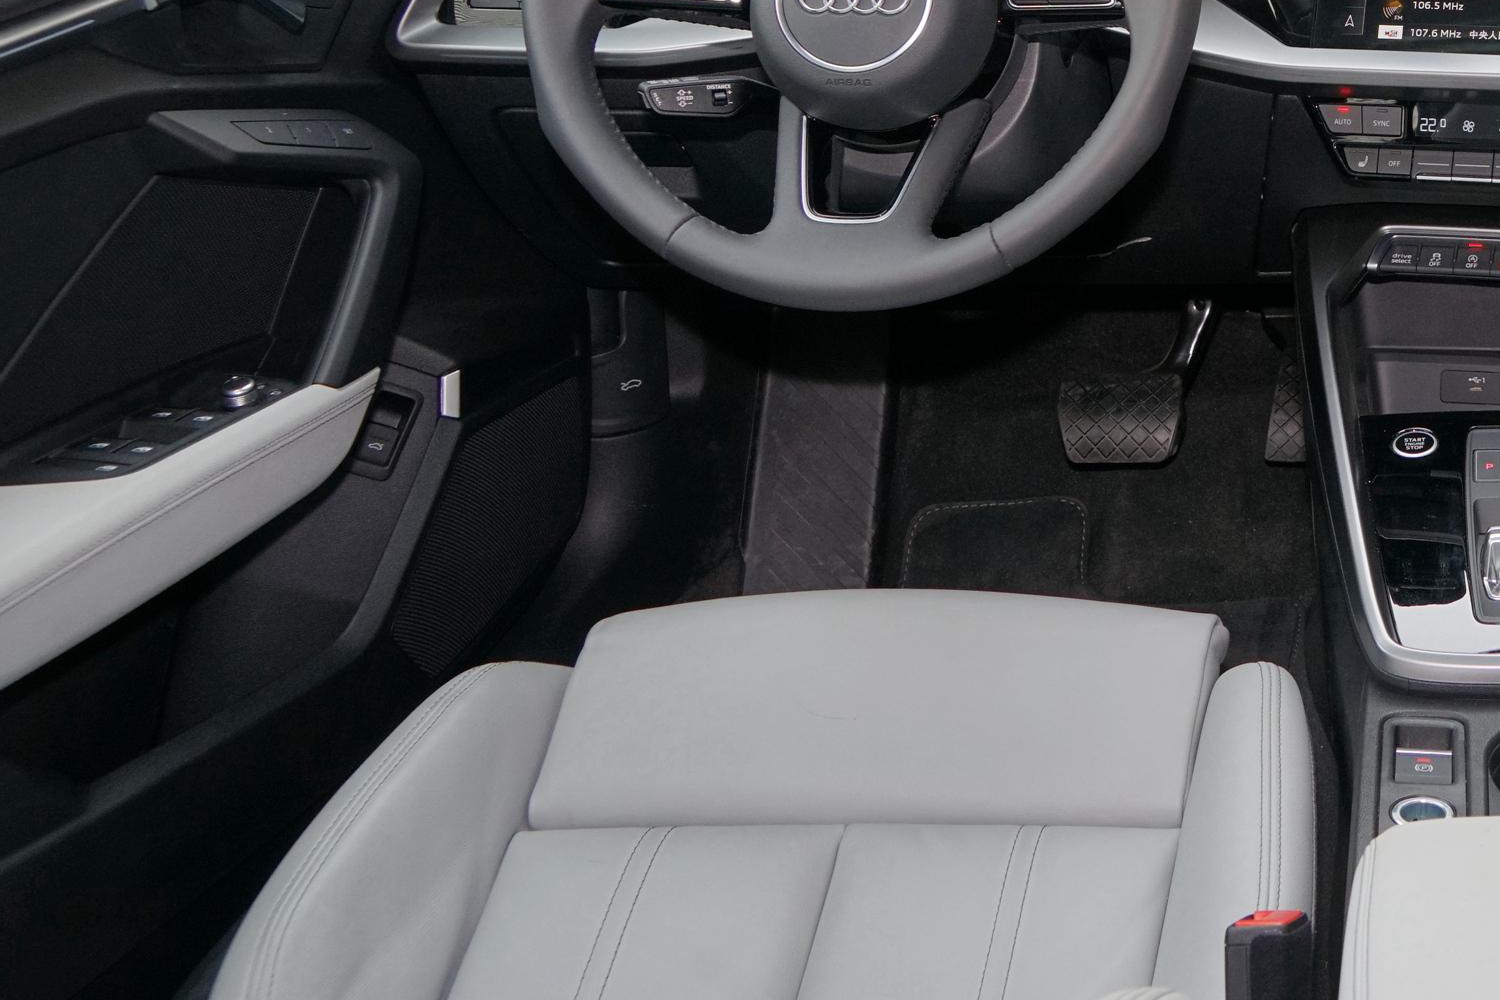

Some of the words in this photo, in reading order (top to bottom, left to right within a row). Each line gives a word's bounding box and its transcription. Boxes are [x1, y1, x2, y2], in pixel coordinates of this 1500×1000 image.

[1413, 1, 1440, 10] 106.5
[1442, 2, 1464, 11] MHz
[1410, 28, 1437, 37] 107.6
[1440, 29, 1462, 39] MHz
[825, 78, 872, 86] AIRBAG
